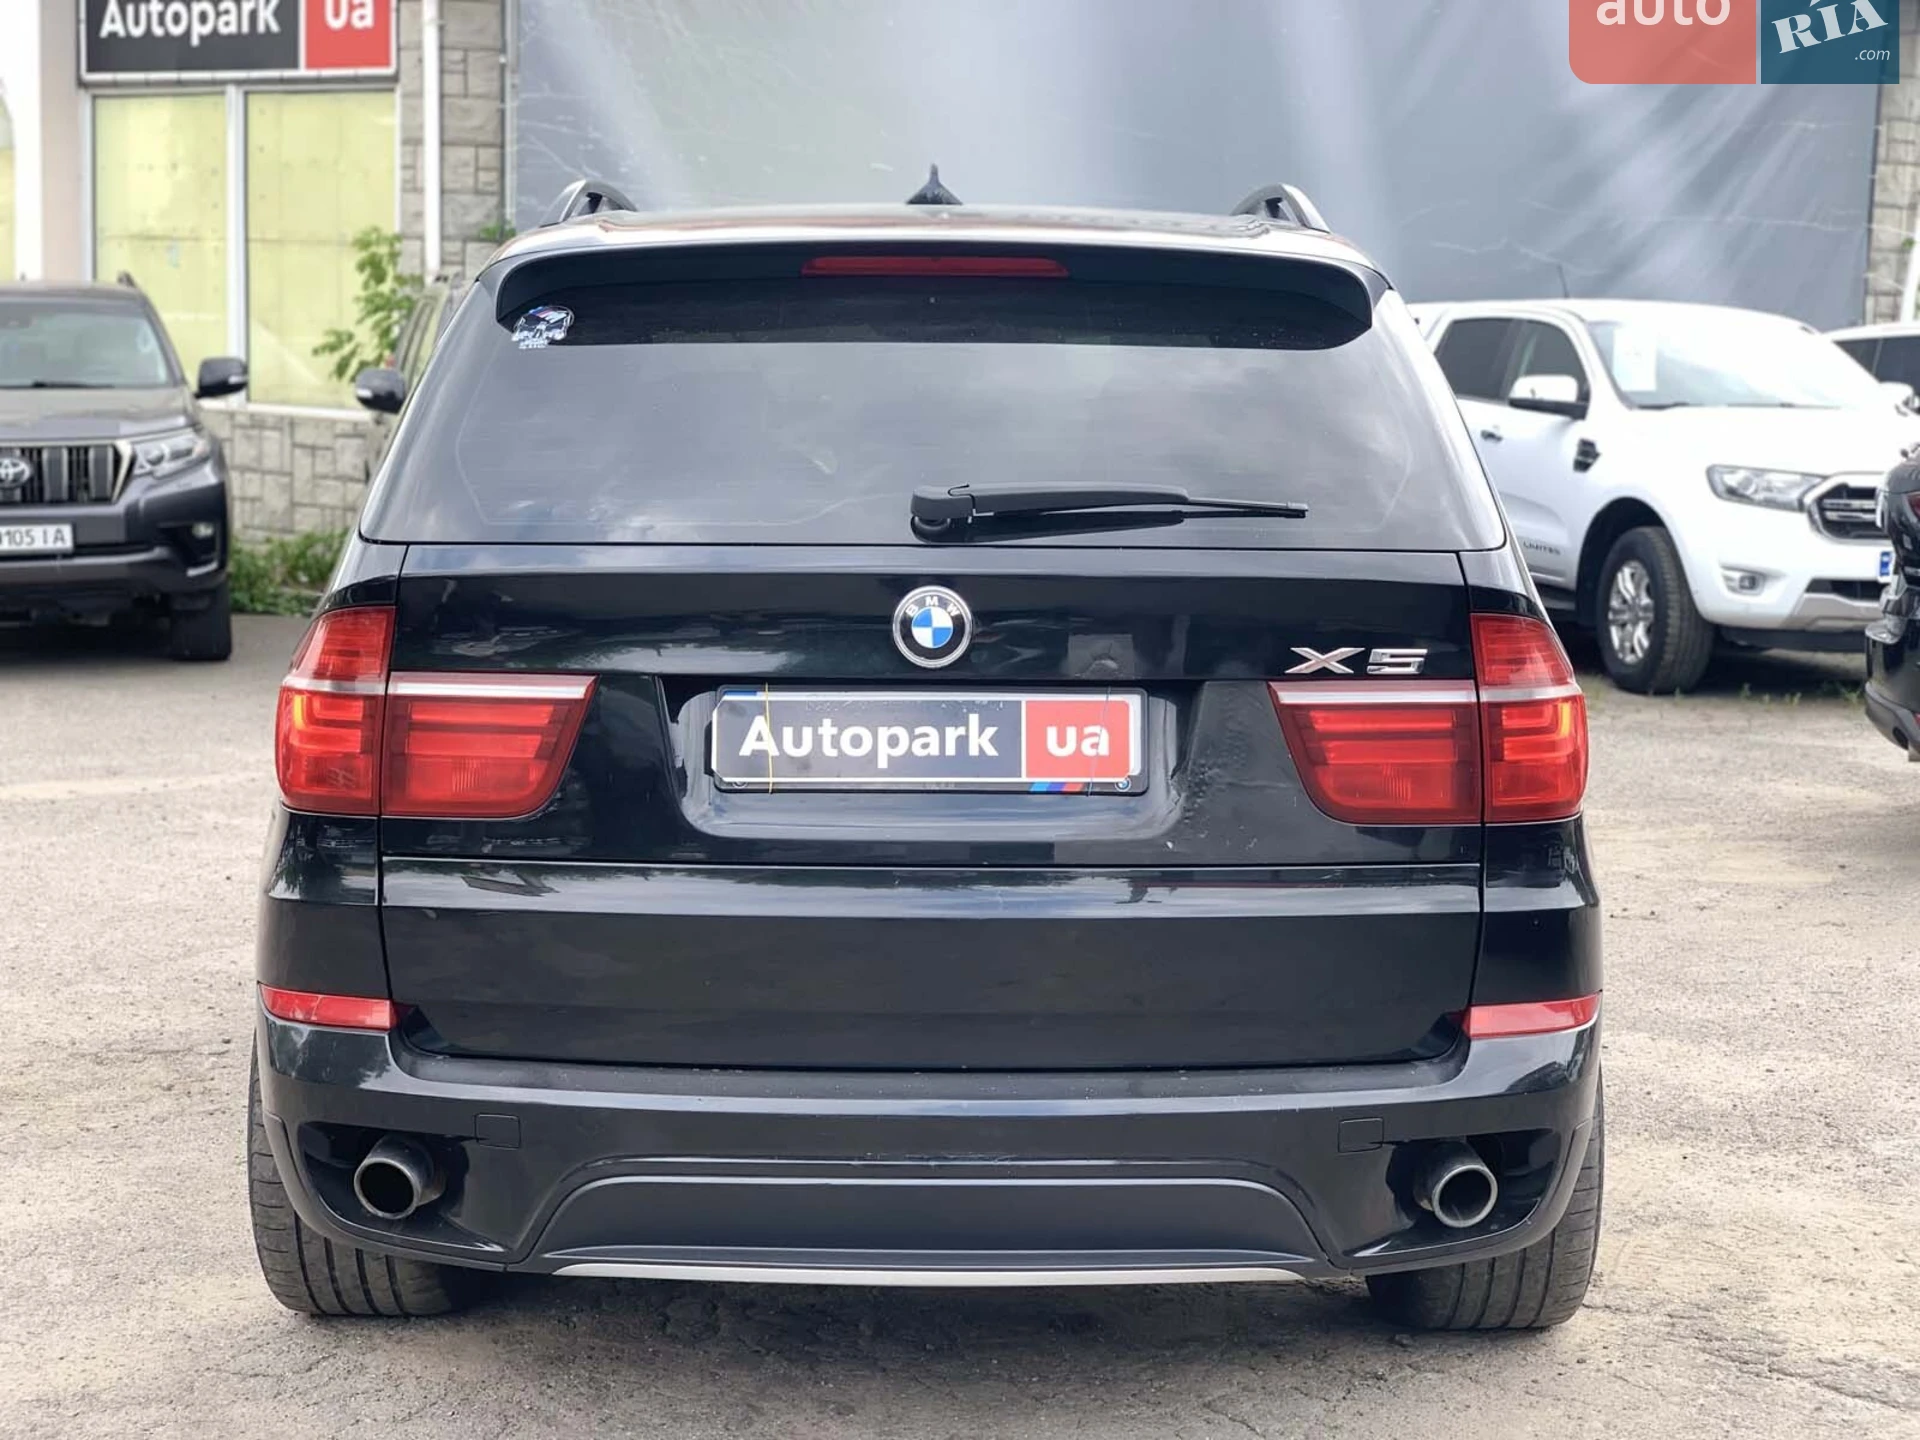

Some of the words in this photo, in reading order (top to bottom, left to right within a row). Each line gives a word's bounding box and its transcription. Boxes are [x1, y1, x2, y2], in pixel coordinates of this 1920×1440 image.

[99, 0, 281, 47] Autopark
[0, 528, 35, 546] 105
[905, 595, 961, 618] BMW
[1284, 647, 1428, 674] X5
[739, 713, 999, 768] Autopark
[1046, 724, 1110, 757] ua
